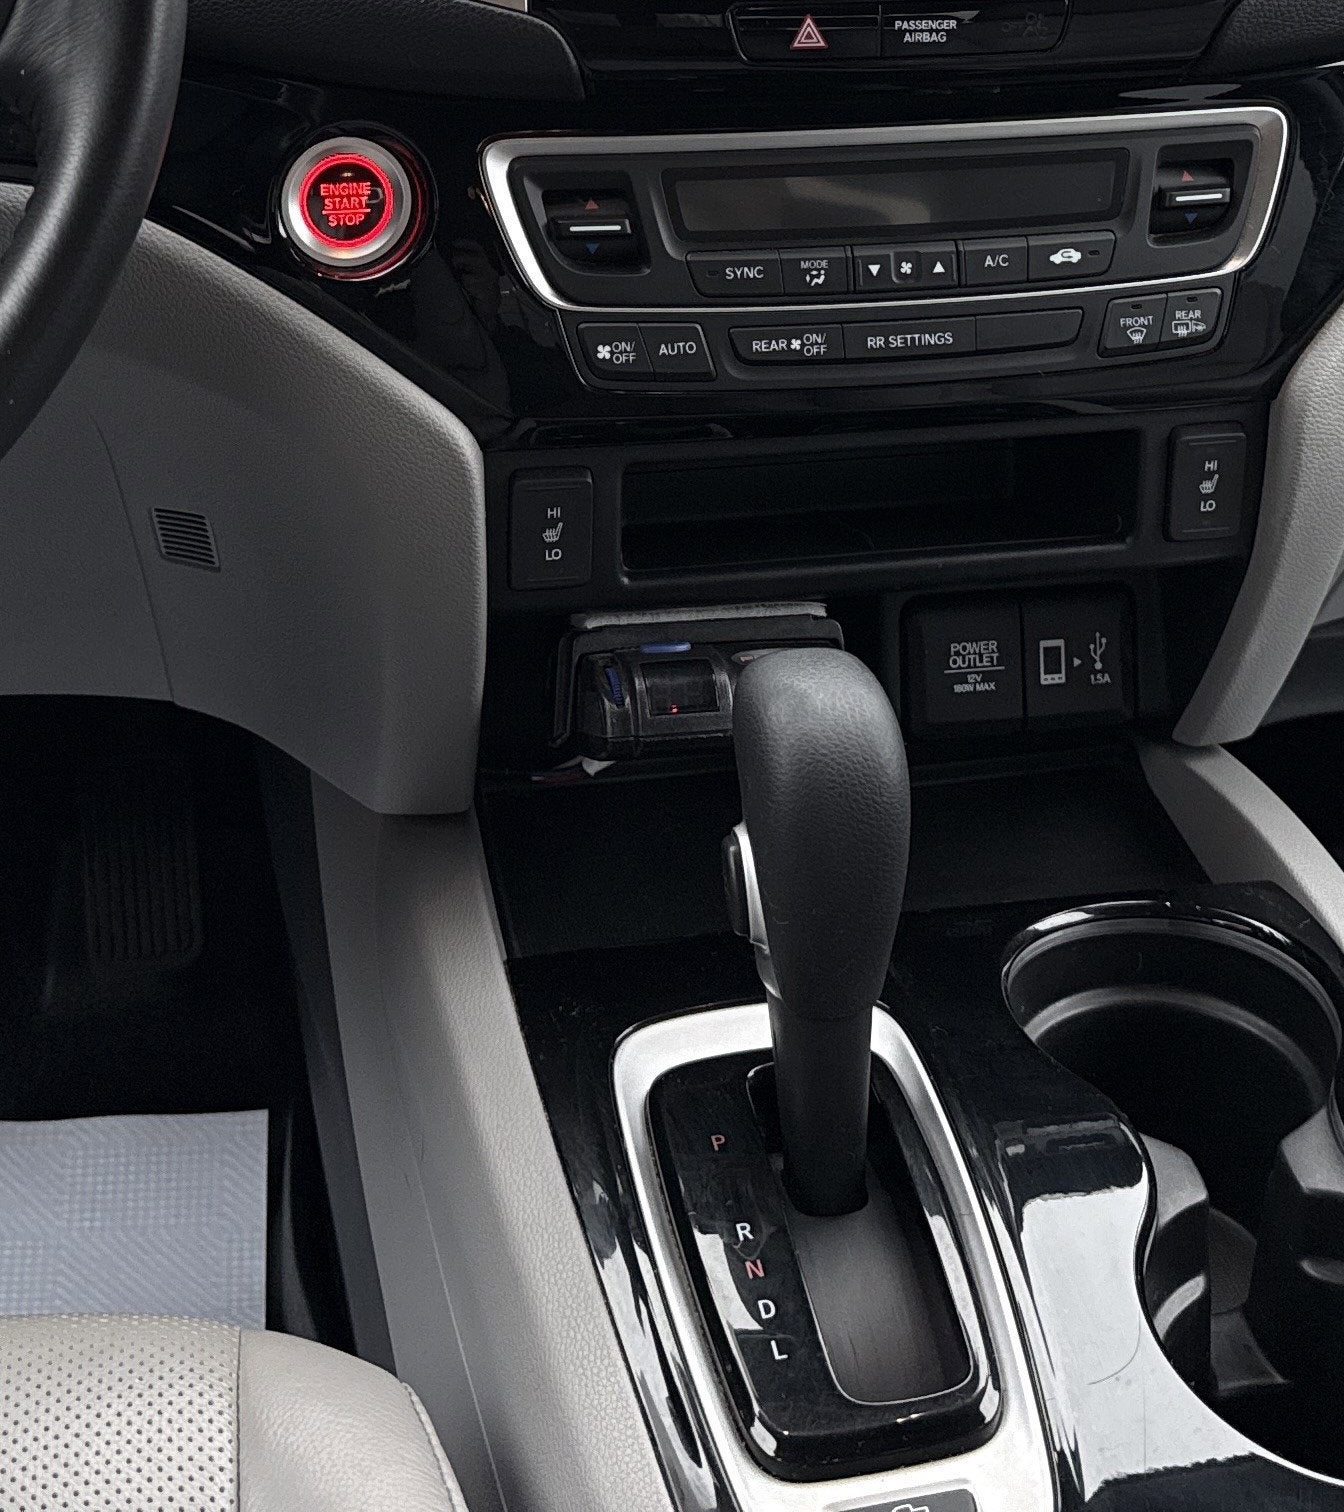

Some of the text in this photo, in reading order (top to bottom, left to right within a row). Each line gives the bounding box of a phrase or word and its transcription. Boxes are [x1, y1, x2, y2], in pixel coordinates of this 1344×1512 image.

[894, 20, 957, 31] PASSENGER
[903, 32, 947, 43] AIRBAG
[320, 181, 372, 196] ENGINE
[324, 197, 368, 210] START
[328, 213, 365, 227] STOP
[800, 259, 829, 270] MODE
[984, 254, 1009, 268] A/C
[725, 266, 764, 280] SYNC
[1175, 309, 1202, 320] REAR
[1120, 315, 1154, 328] FRONT
[803, 333, 826, 345] ON/
[867, 332, 953, 349] RR SETTINGS
[612, 341, 635, 353] ON/
[658, 342, 697, 357] AUTO
[752, 339, 788, 353] REAR
[803, 345, 828, 357] OFF
[612, 353, 636, 365] OFF
[1204, 459, 1218, 472] HI
[1200, 499, 1216, 512] LO
[547, 506, 561, 519] HI
[545, 548, 562, 561] LO
[950, 640, 998, 656] POWER
[948, 653, 999, 669] OUTLET
[966, 673, 983, 683] 12V
[975, 681, 996, 692] MAX
[710, 1134, 726, 1151] P
[735, 1222, 755, 1241] R
[744, 1258, 765, 1279] N
[757, 1299, 776, 1319] D
[770, 1340, 789, 1360] L
